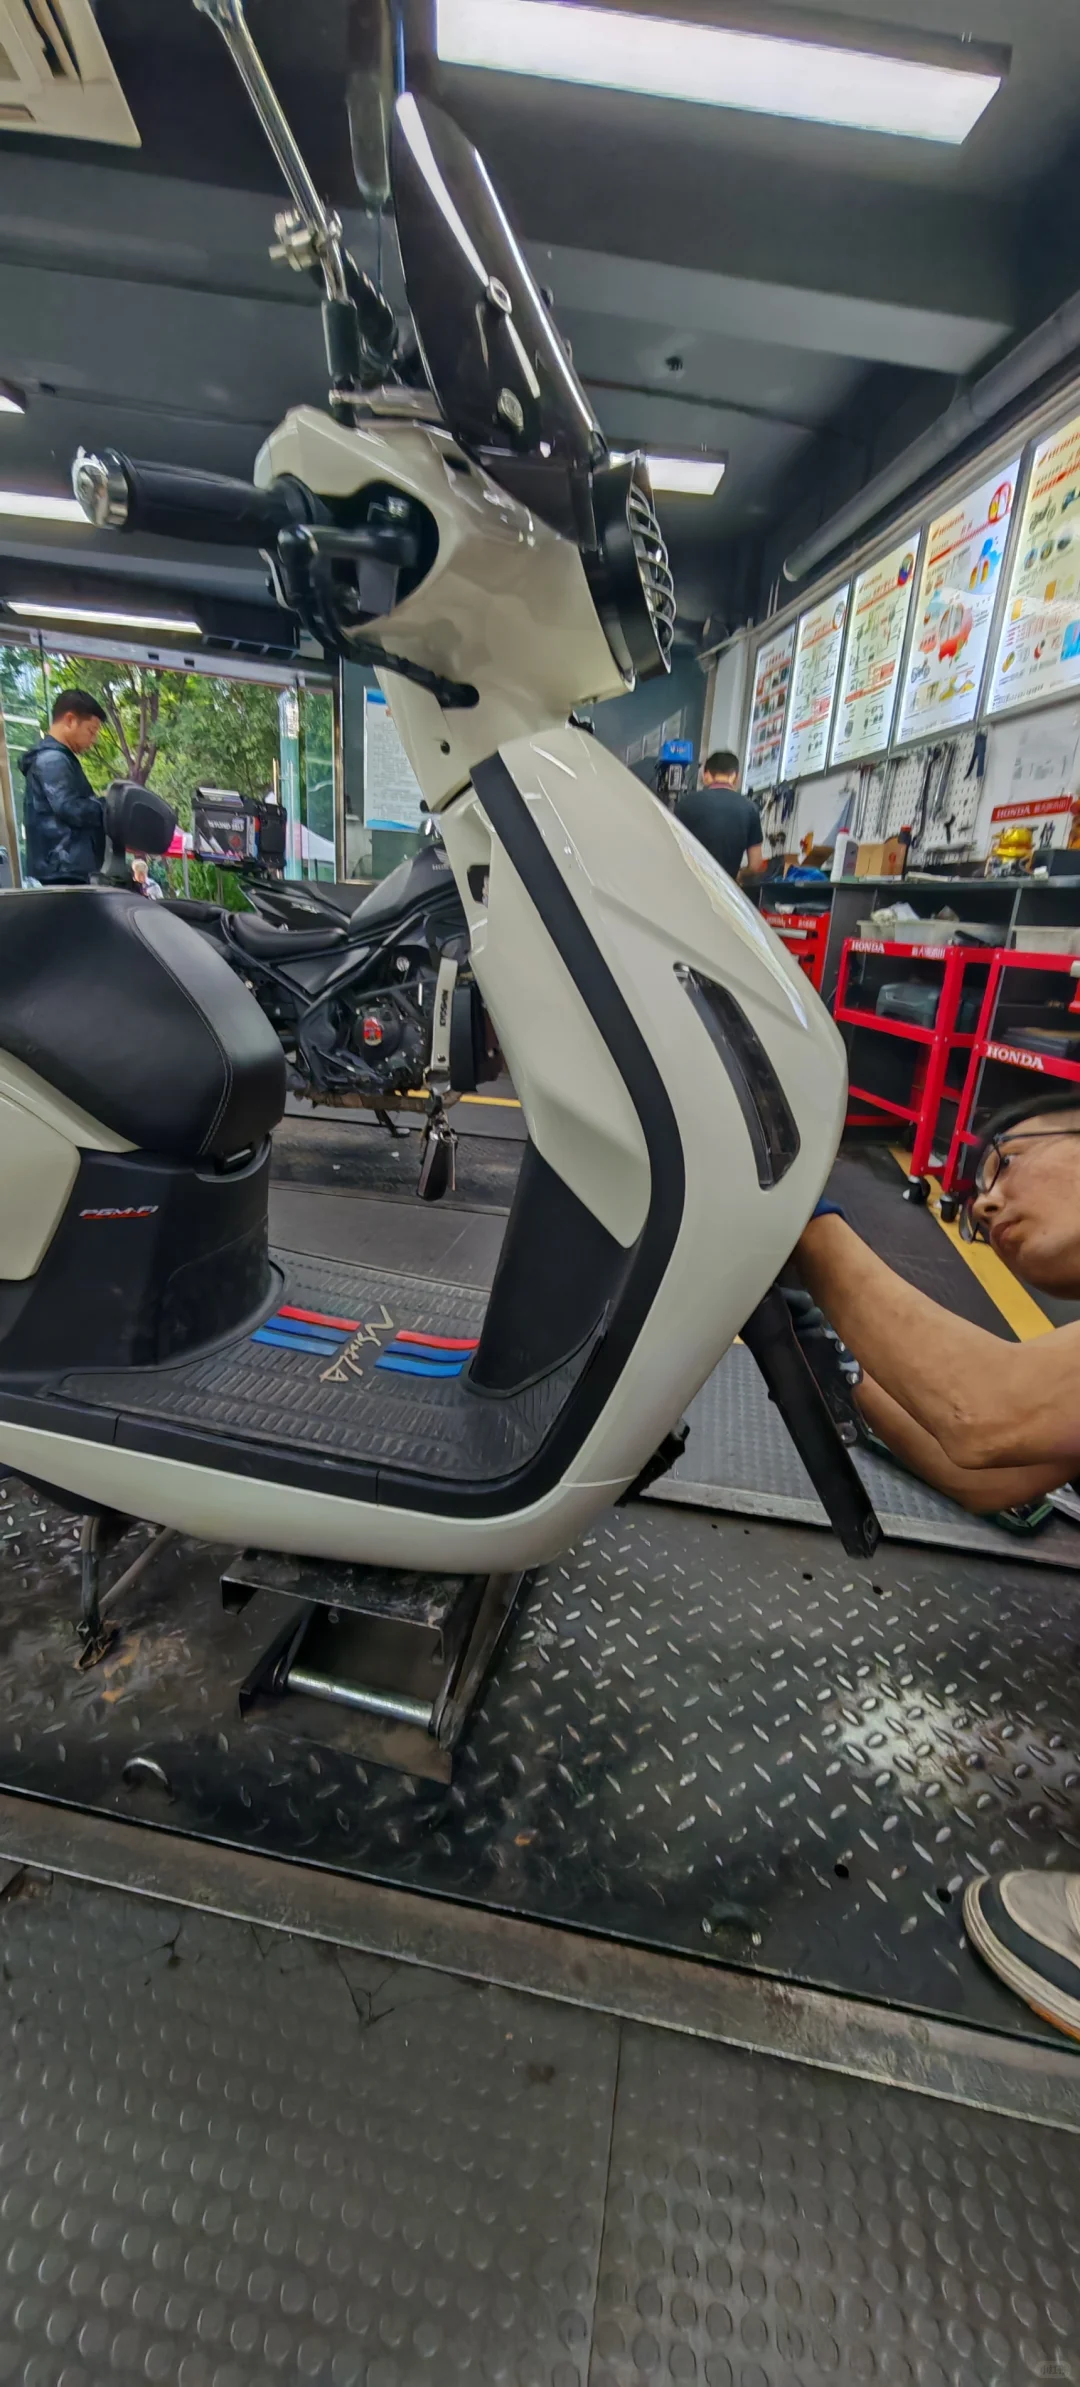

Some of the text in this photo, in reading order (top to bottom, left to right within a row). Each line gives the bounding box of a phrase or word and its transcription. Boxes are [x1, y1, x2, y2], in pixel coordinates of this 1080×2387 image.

[996, 805, 1030, 820] HONDA
[851, 939, 885, 954] HONDA
[986, 1044, 1044, 1071] HONDA
